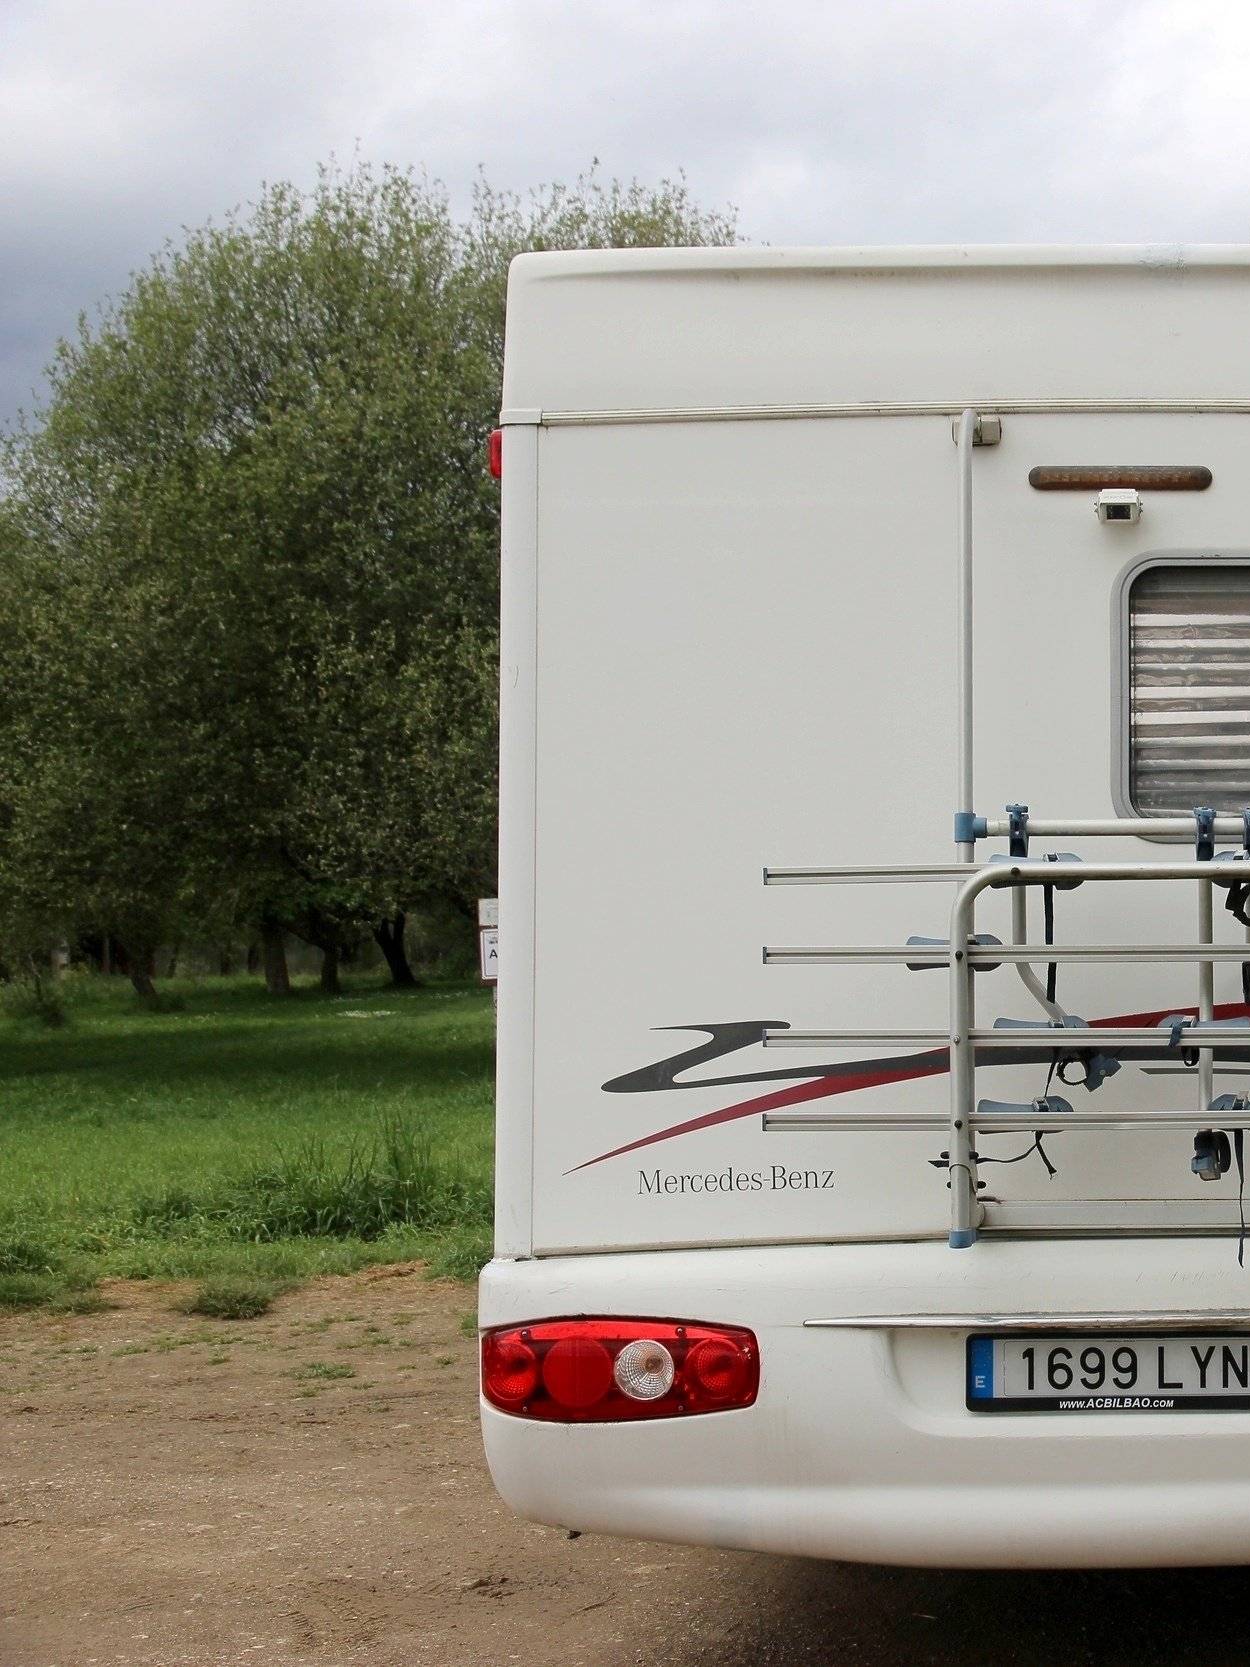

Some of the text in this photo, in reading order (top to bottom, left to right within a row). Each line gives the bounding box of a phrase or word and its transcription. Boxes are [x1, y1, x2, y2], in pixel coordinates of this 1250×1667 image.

[637, 1164, 835, 1195] Mercedes-Benz
[975, 1375, 986, 1388] E
[1021, 1344, 1249, 1391] 1699 LYN
